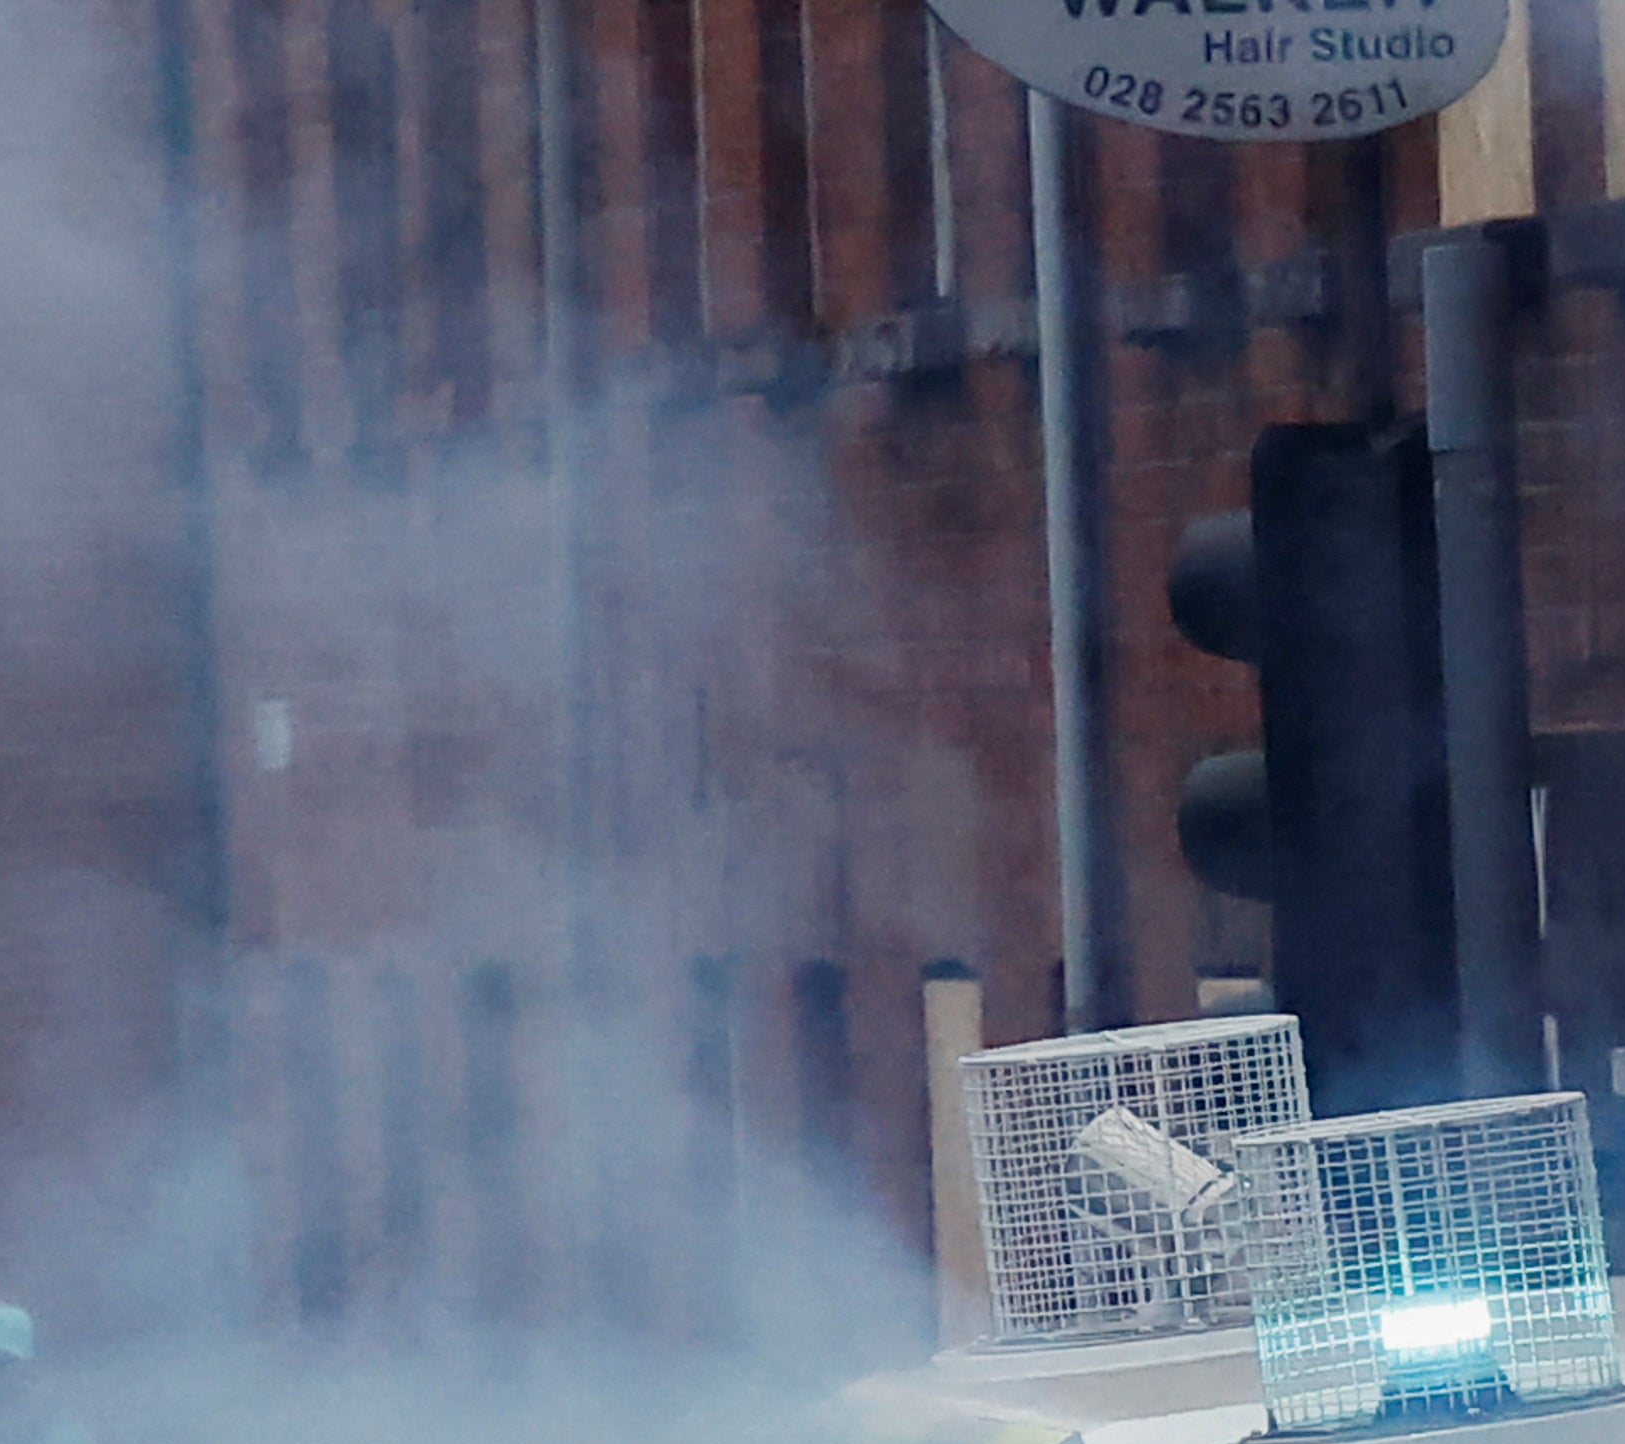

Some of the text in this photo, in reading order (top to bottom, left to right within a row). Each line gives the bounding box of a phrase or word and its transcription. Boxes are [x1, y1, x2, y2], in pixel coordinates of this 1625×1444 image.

[1205, 27, 1456, 64] Hair Studio
[1084, 66, 1408, 128] 028 2563 2611
